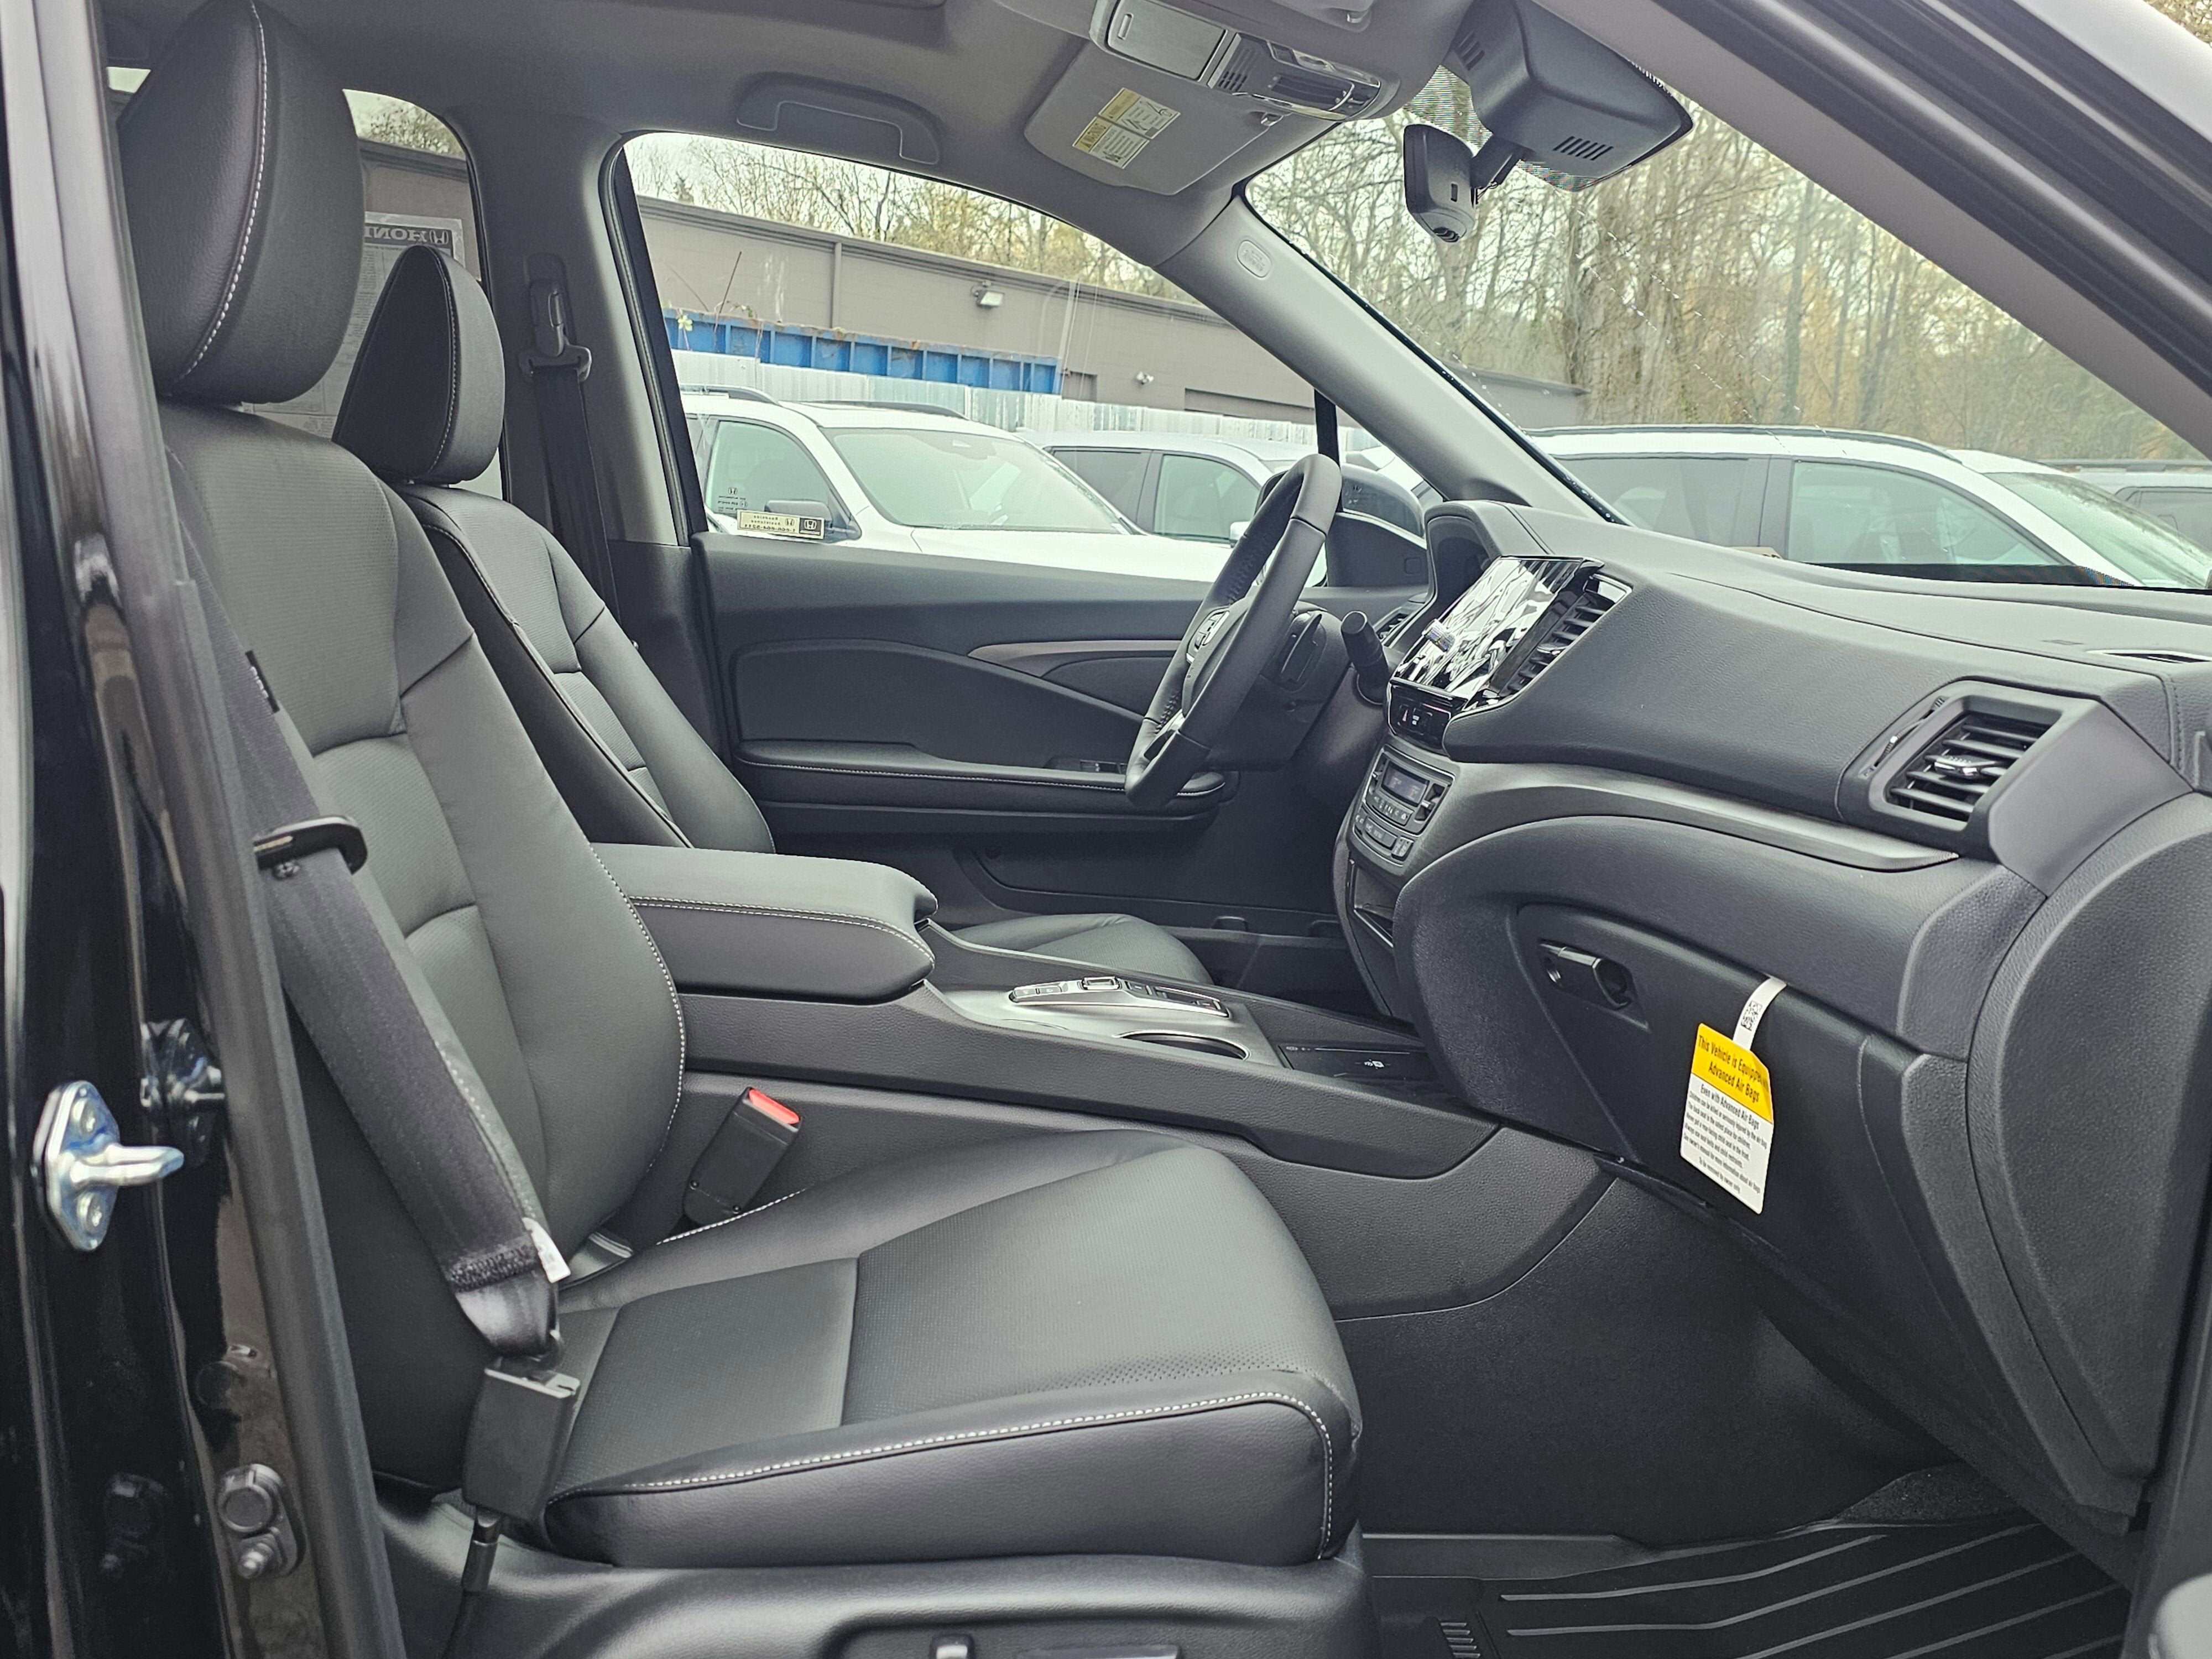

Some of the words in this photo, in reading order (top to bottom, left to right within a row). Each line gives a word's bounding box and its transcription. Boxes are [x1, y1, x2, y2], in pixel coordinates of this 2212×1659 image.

[1698, 1034, 1709, 1052] This
[1710, 1041, 1731, 1065] Vehicle
[1731, 1054, 1737, 1068] is
[1708, 1058, 1735, 1087] Advanced
[1735, 1076, 1744, 1093] Air
[1745, 1083, 1760, 1105] Bags
[1700, 1083, 1710, 1098] Even
[1711, 1090, 1720, 1103] with
[1720, 1095, 1740, 1118] Advanced
[1748, 1114, 1759, 1131] Bags
